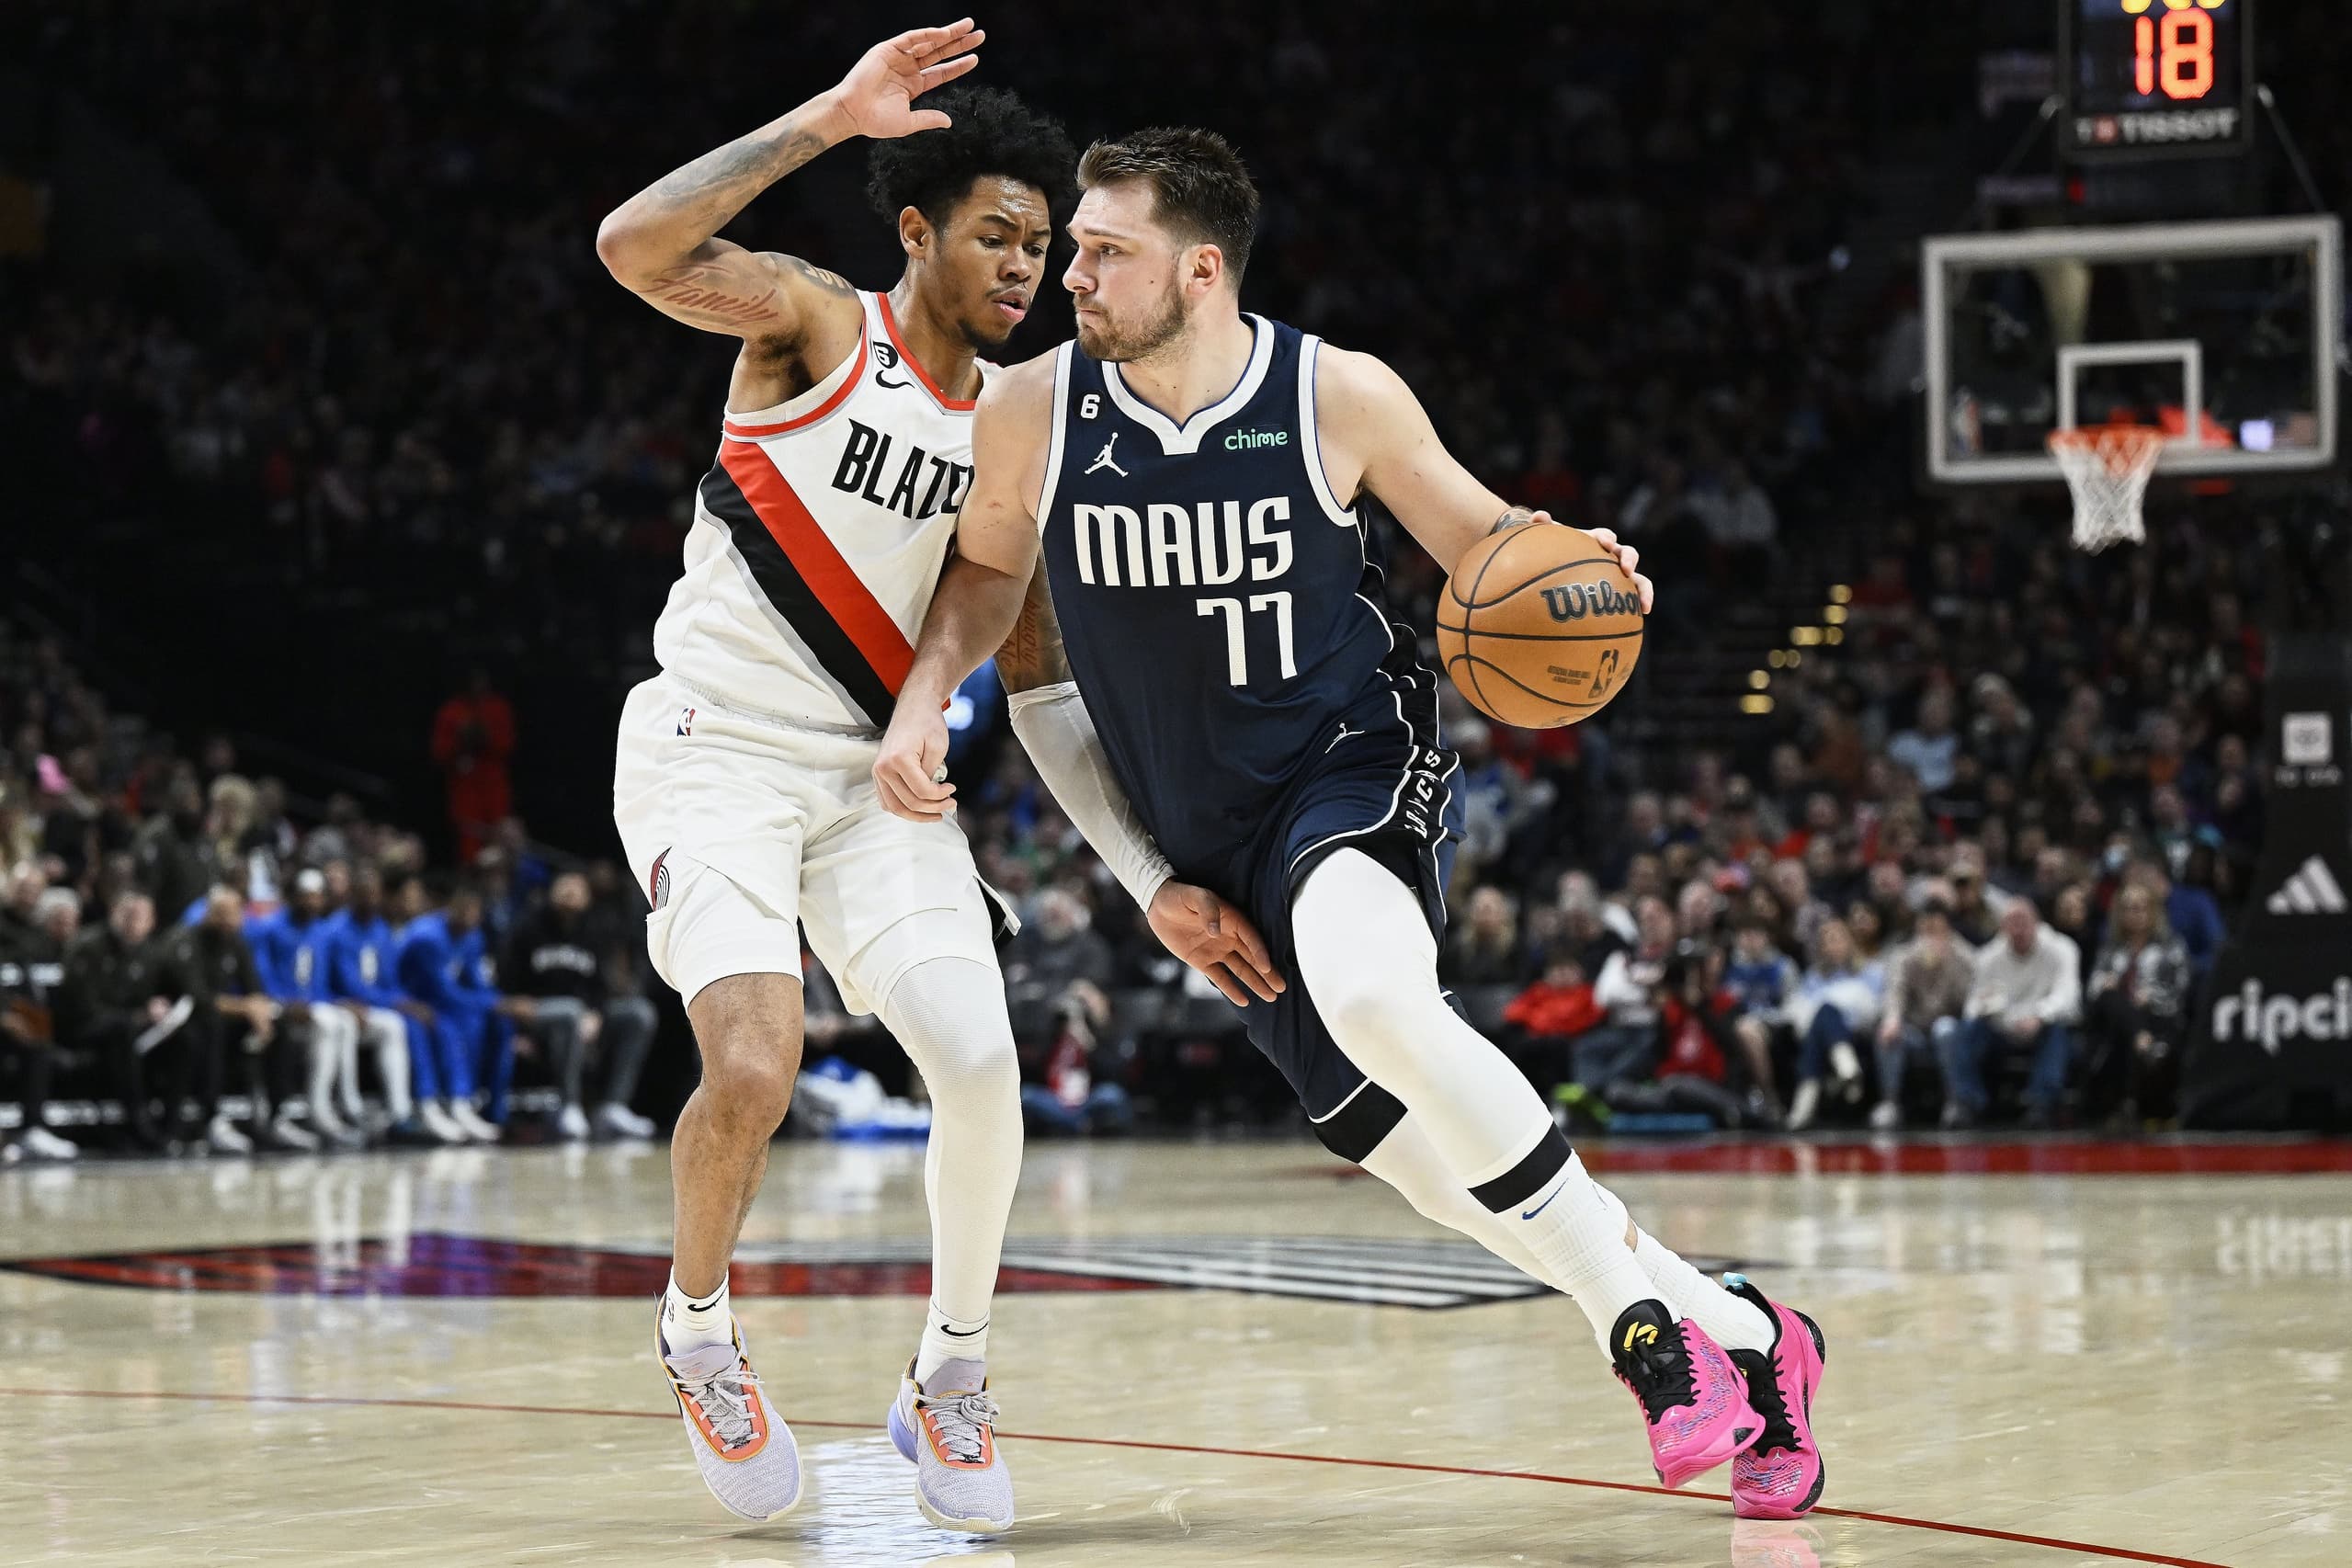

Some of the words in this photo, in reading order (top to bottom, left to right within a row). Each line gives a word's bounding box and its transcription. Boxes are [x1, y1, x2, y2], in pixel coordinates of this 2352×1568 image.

[2135, 7, 2213, 99] 18
[1080, 393, 1101, 420] 6
[1224, 428, 1289, 451] chime
[1074, 496, 1293, 587] MAVS
[1196, 591, 1298, 686] 77
